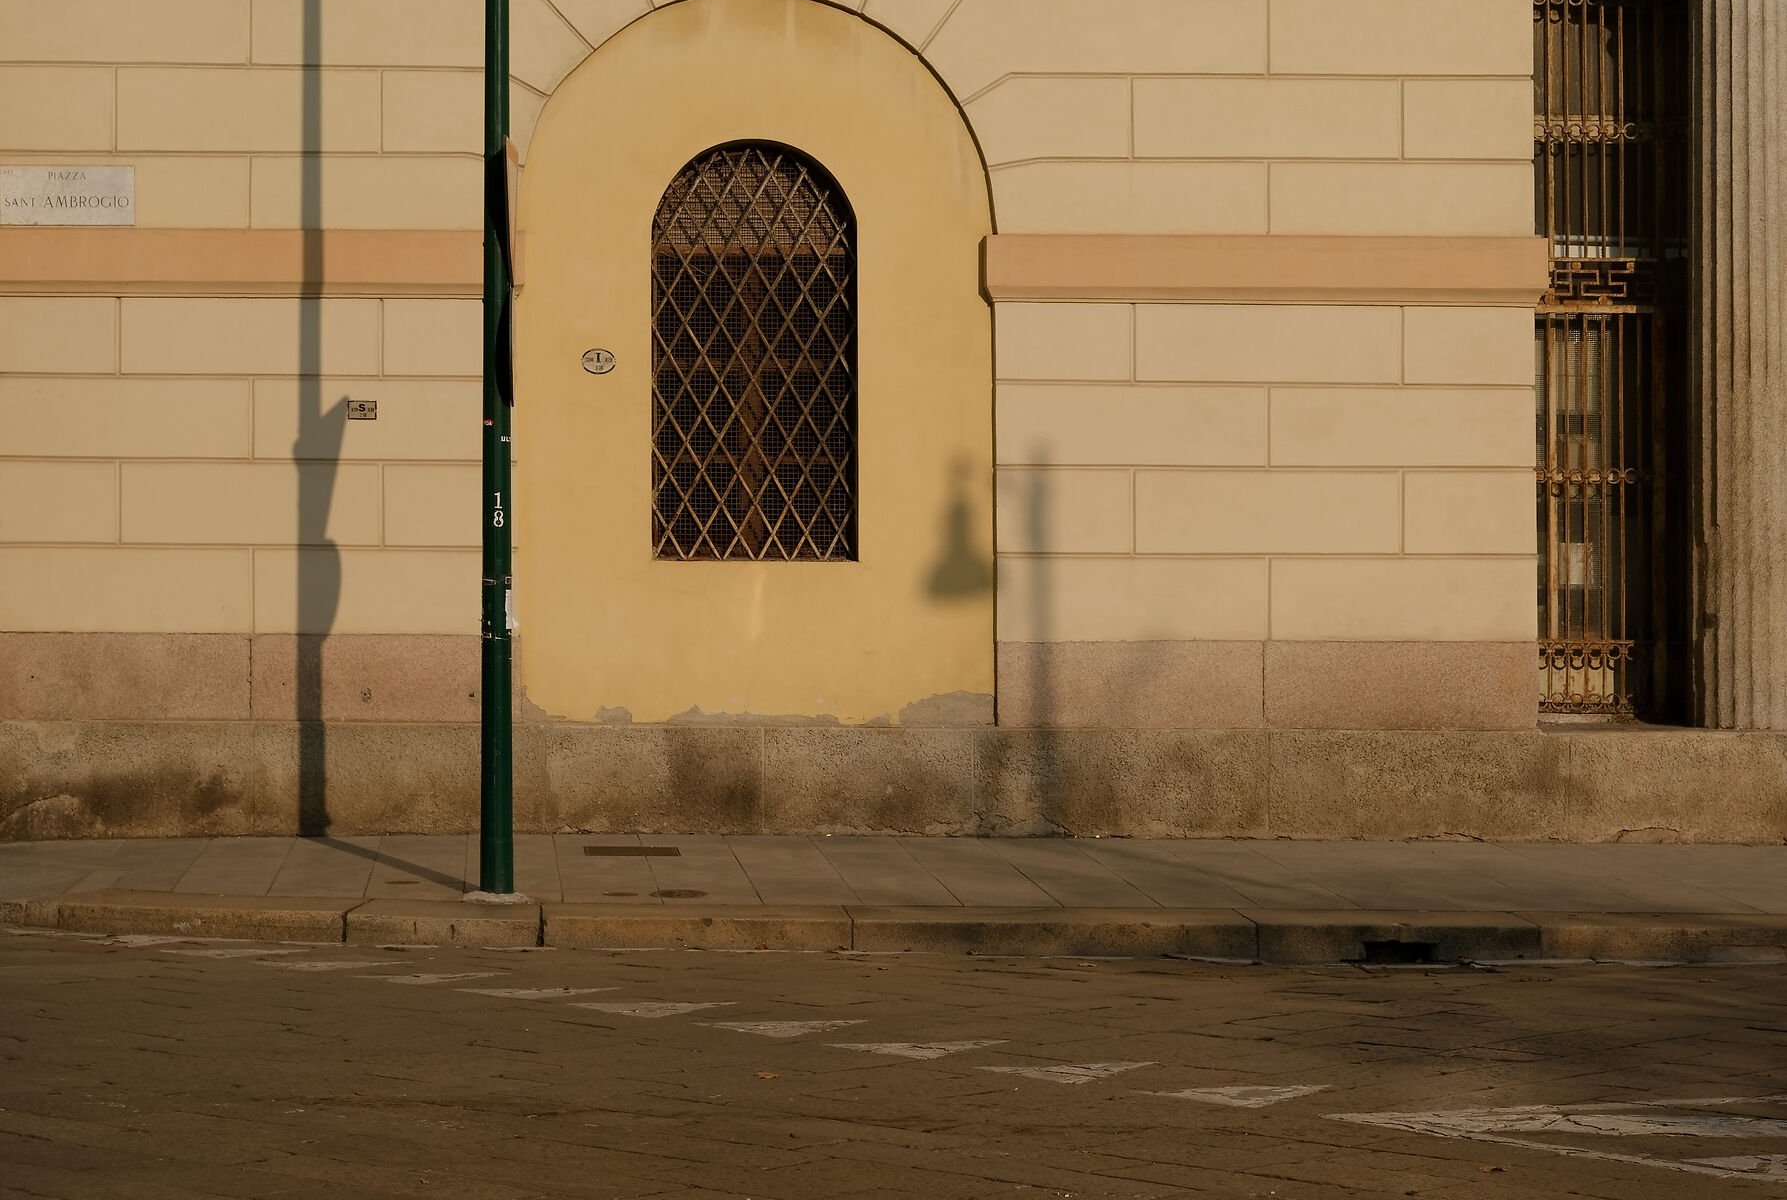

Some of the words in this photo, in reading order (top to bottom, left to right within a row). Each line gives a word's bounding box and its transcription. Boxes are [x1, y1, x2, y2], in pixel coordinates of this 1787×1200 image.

[48, 171, 87, 180] PIAZZA
[43, 195, 130, 208] AMBROGIO
[359, 403, 366, 412] S
